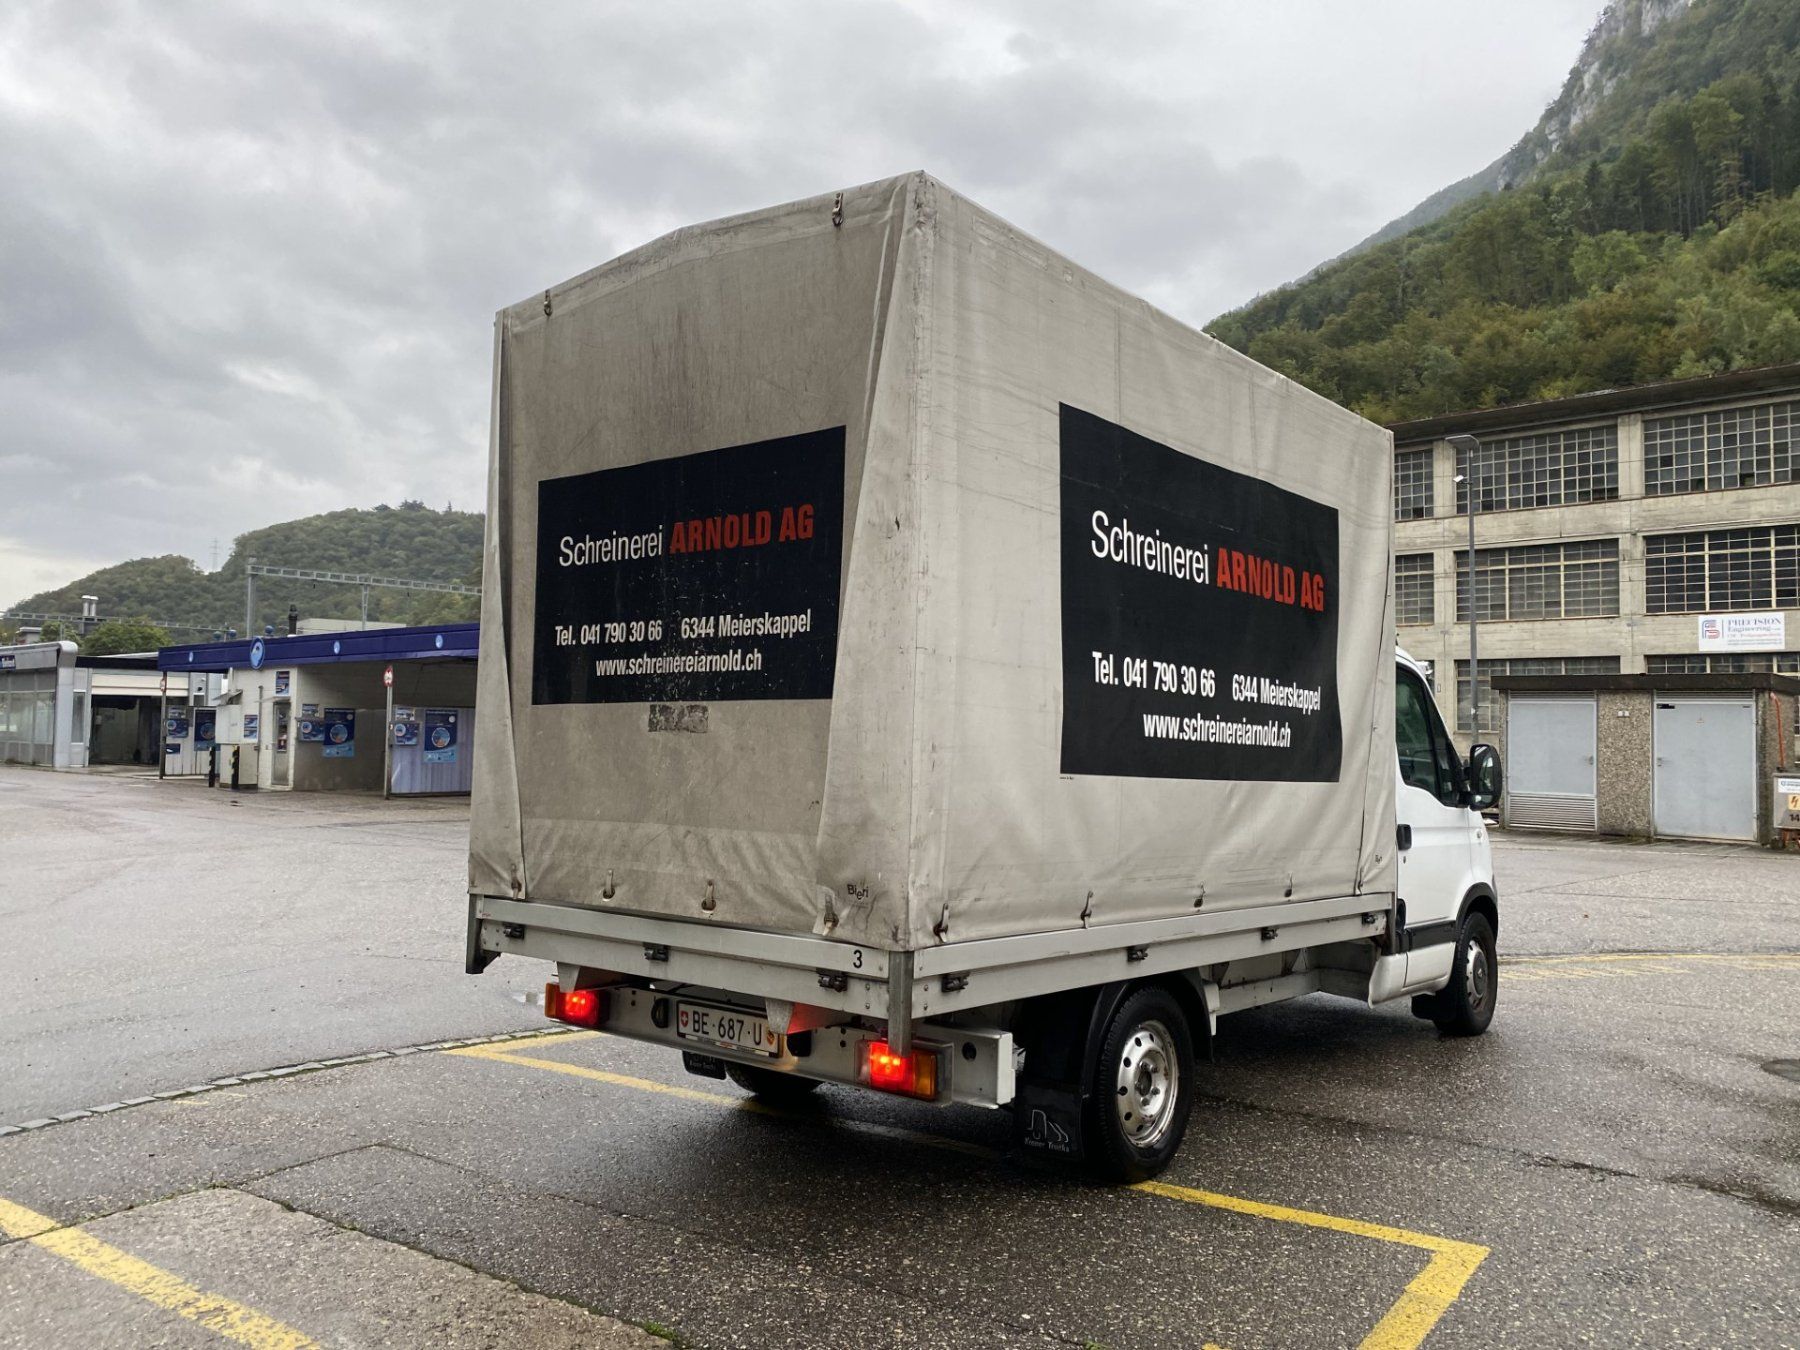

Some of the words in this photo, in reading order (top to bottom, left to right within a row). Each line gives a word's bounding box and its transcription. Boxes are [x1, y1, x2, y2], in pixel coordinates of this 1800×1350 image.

[559, 525, 663, 567] Schreinerei
[669, 510, 772, 554] ARNOLD
[778, 503, 815, 542] AG
[1091, 510, 1210, 584] Schreinerei
[1216, 547, 1296, 605] ARNOLD
[1300, 571, 1325, 612] AG
[555, 625, 576, 646] Tel.
[580, 624, 600, 645] 041
[604, 622, 627, 643] 790
[629, 621, 645, 642] 30
[648, 620, 662, 641] 66
[681, 616, 715, 639] 6344
[718, 608, 811, 639] Meierskappel
[595, 648, 762, 677] www.schreinereiarnold.ch
[1092, 651, 1119, 685] Tel.
[1123, 656, 1148, 689] 041
[1152, 661, 1178, 693] 790
[1181, 665, 1197, 695] 30
[1200, 668, 1216, 698] 66
[1232, 674, 1258, 703] 6344
[1260, 677, 1321, 715] Meierskappel
[1143, 713, 1291, 748] www.schreinereiarnold.ch
[847, 884, 869, 900] Bieri
[853, 949, 863, 969] 3
